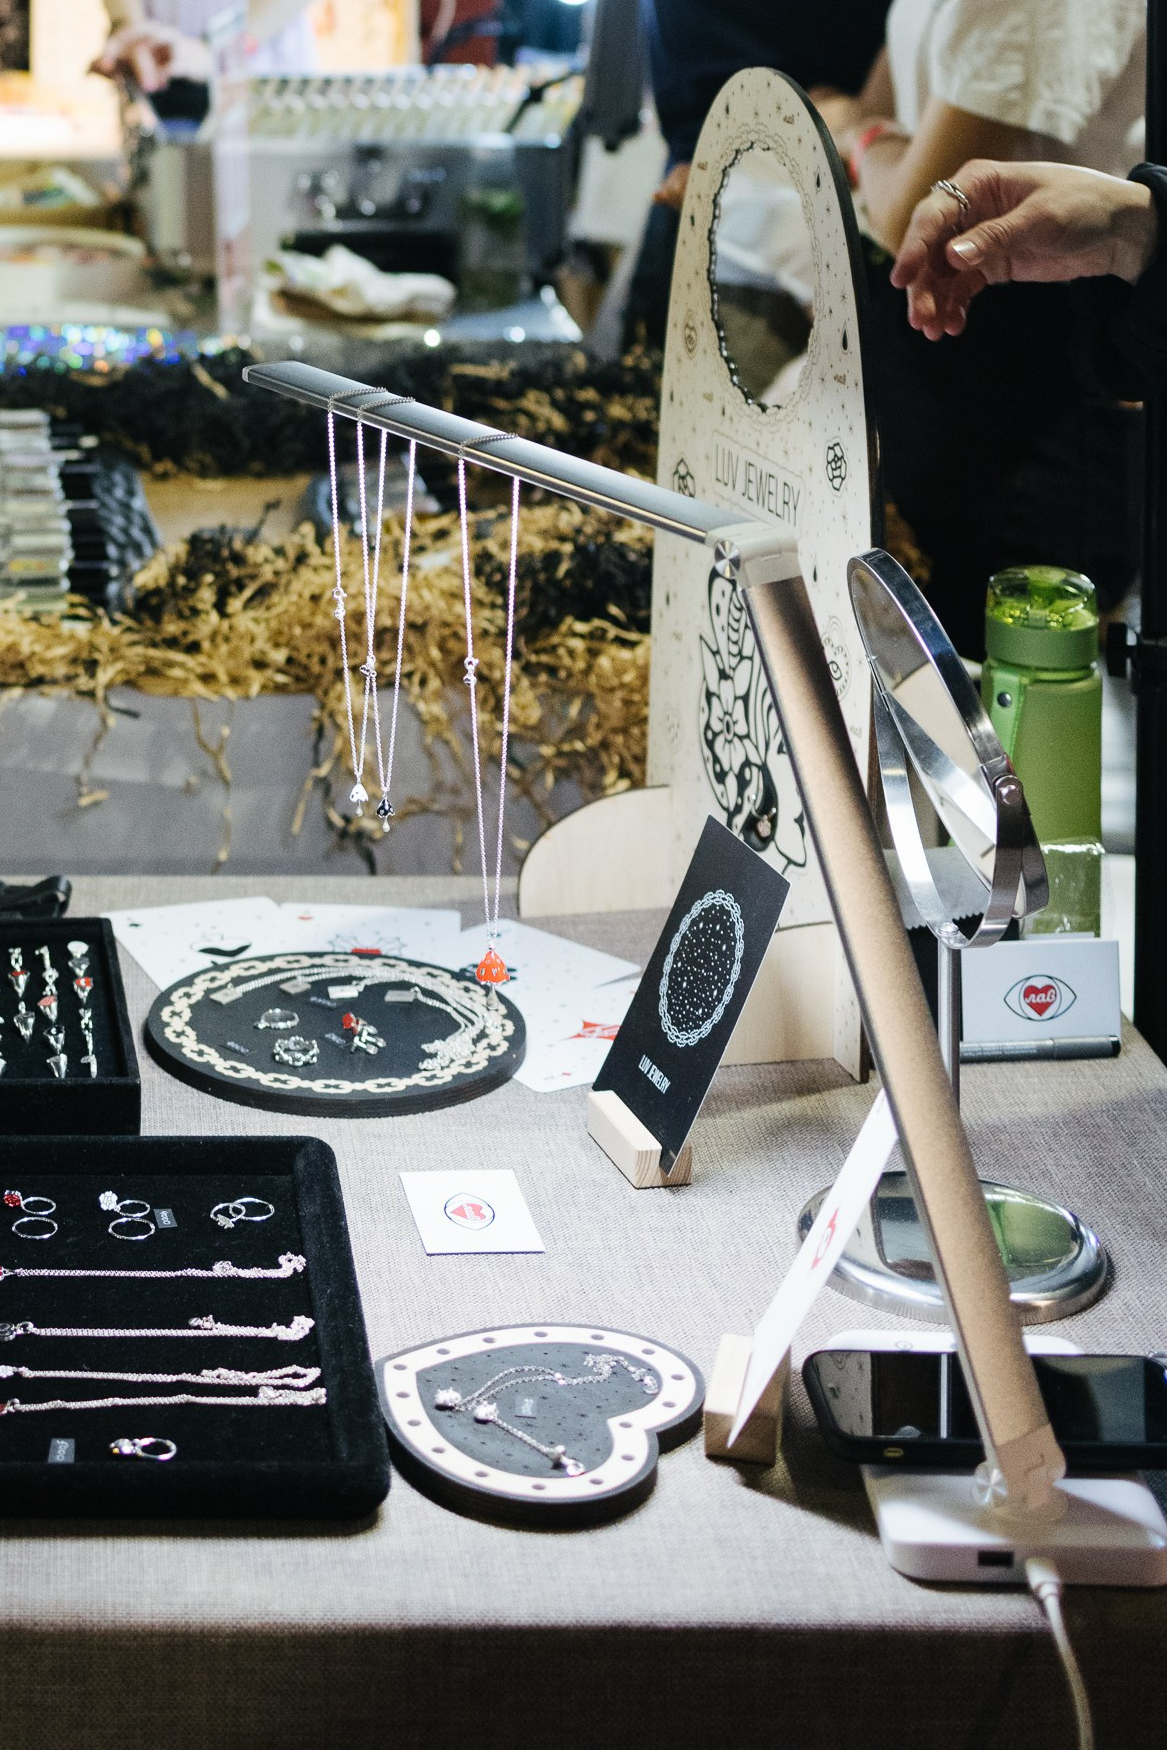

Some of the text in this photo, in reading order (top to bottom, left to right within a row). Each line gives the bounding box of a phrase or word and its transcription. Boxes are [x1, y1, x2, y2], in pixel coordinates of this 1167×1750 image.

[715, 443, 801, 527] LUV JEWELRY
[638, 1054, 671, 1094] LUV JEWELRY
